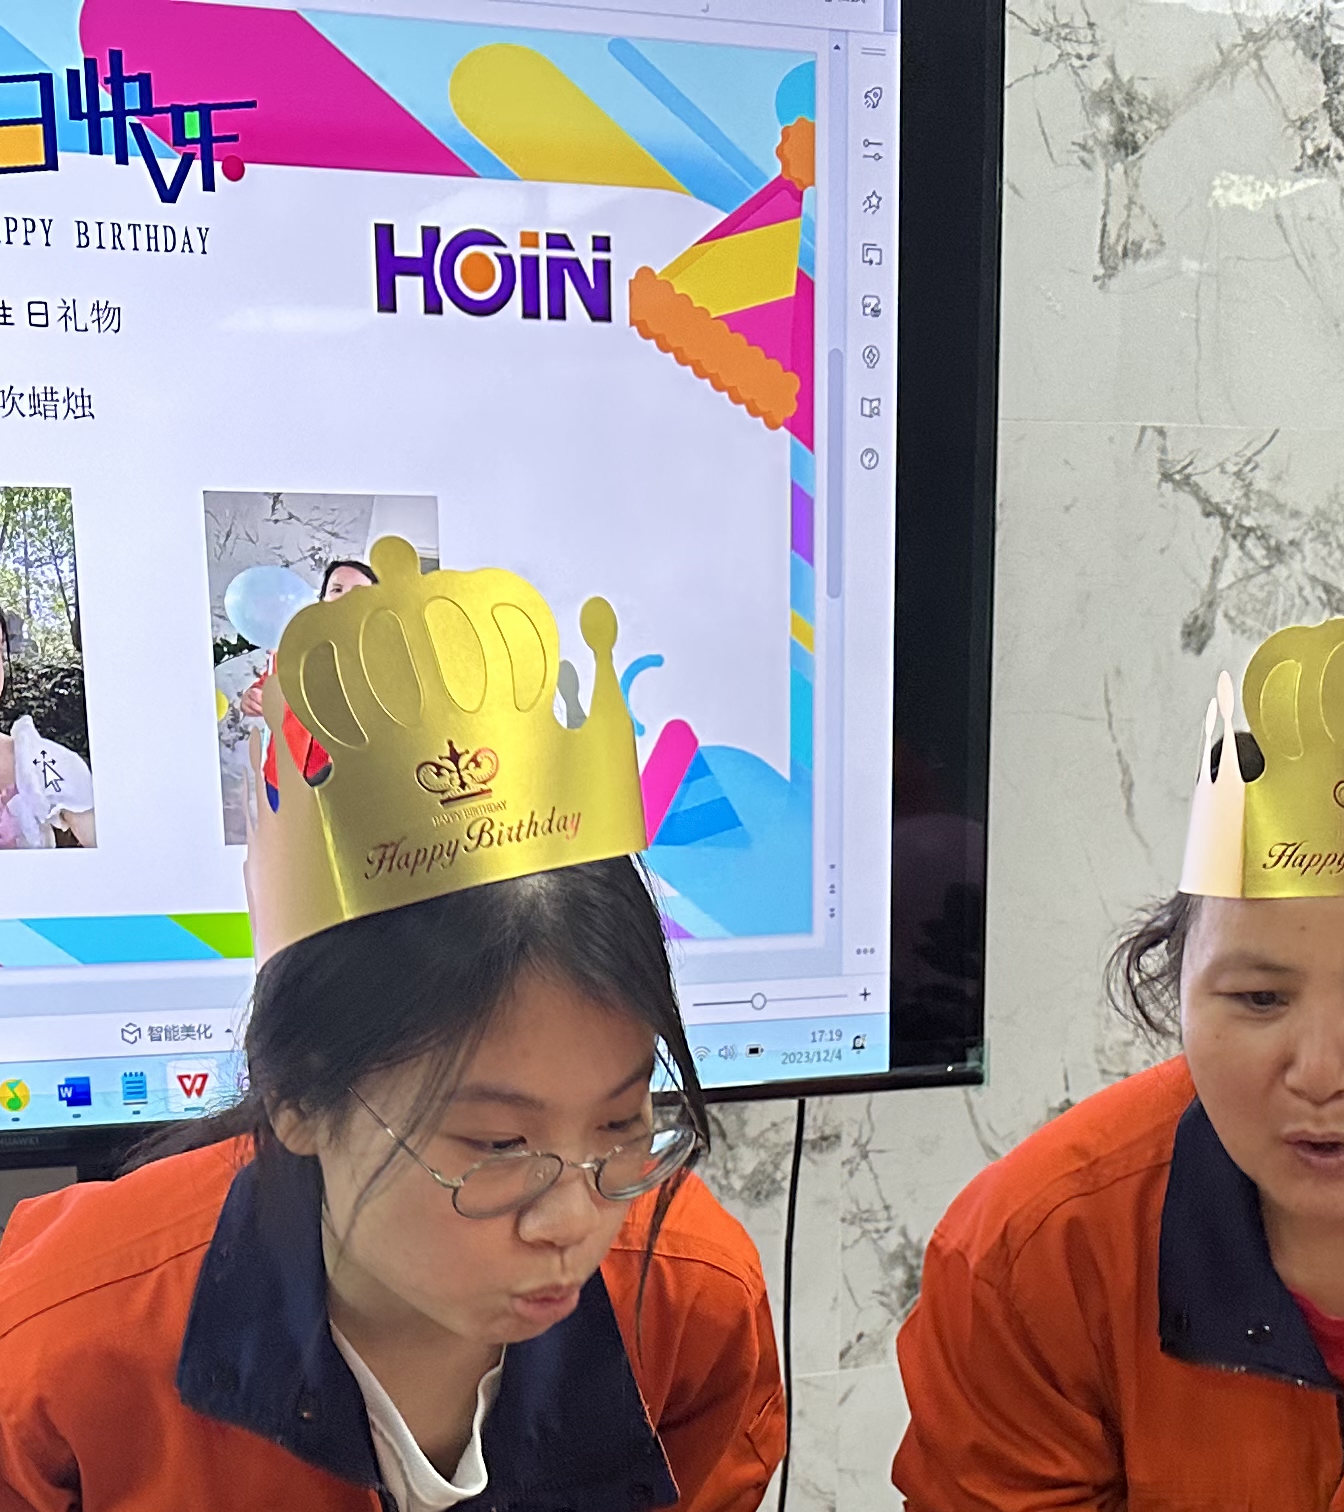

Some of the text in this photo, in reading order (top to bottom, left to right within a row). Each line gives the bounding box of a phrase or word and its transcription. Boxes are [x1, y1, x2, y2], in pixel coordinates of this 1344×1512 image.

[76, 220, 212, 257] BIRTHDAY
[364, 807, 582, 881] Happy Birthday
[147, 1023, 214, 1043] 智能美化
[810, 1029, 843, 1043] 17:19
[781, 1048, 843, 1065] 2023/12/4
